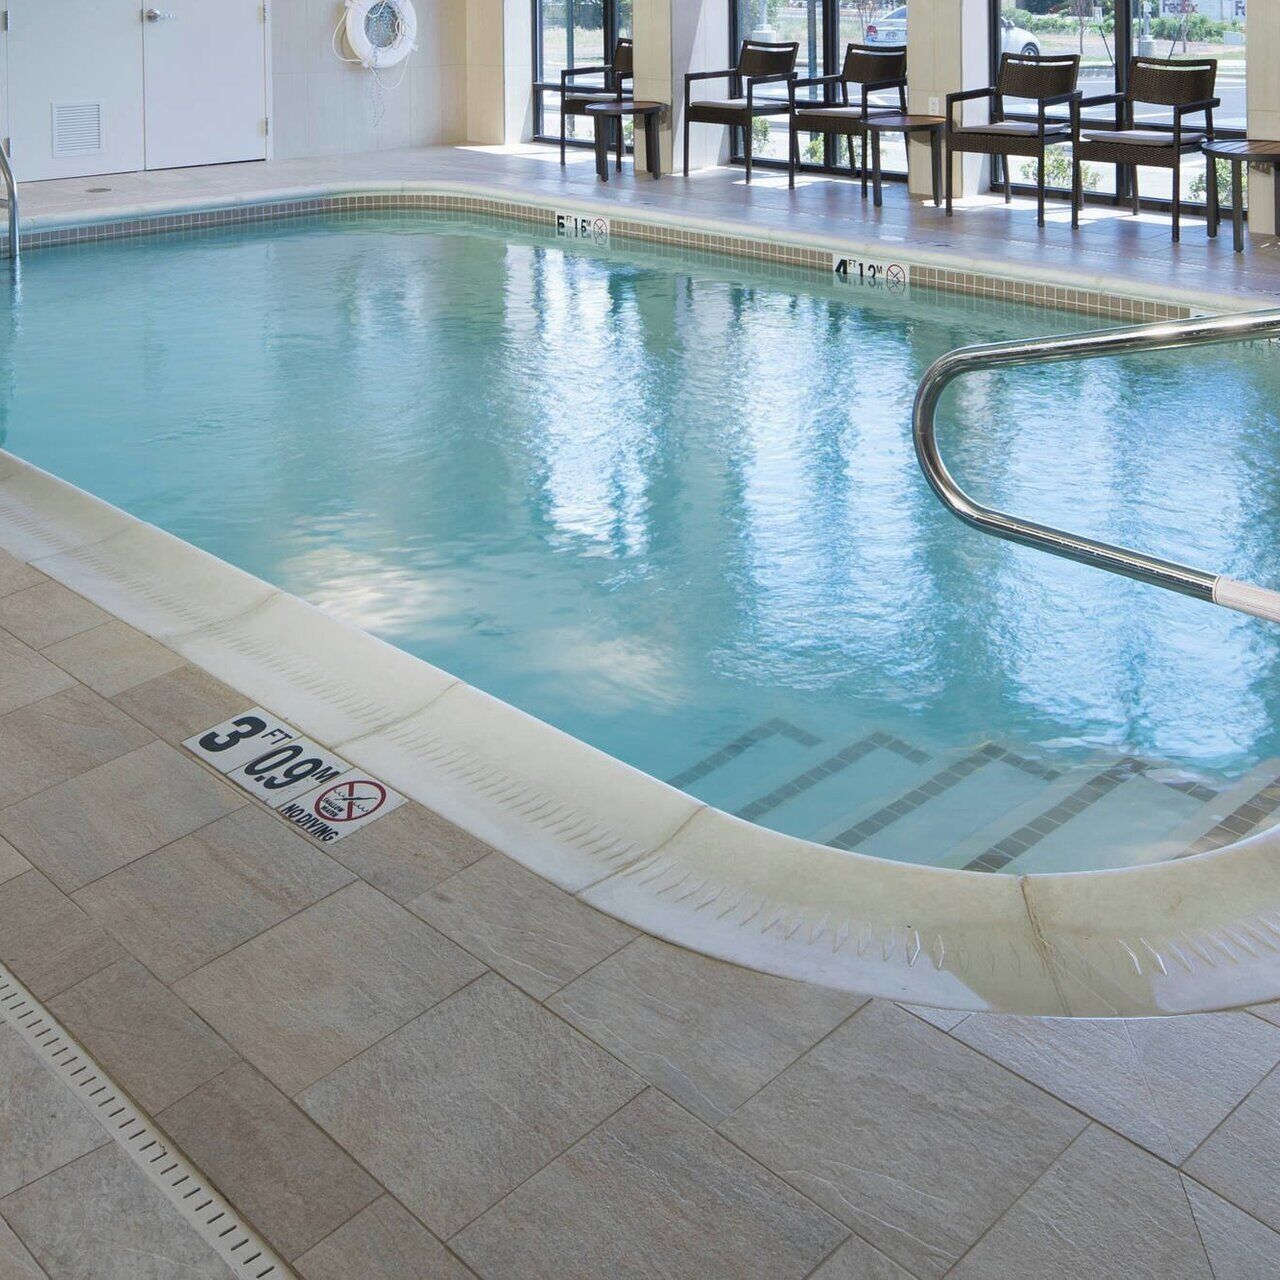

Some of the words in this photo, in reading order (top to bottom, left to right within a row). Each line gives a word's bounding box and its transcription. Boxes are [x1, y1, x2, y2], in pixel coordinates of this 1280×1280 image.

[835, 258, 848, 275] 4
[848, 259, 857, 268] FT
[876, 265, 883, 275] M
[198, 716, 267, 752] 3
[261, 728, 293, 745] FT
[244, 744, 324, 790] 0.9
[311, 765, 340, 784] M
[321, 805, 339, 818] WATER
[323, 797, 345, 813] SHALLOW
[281, 803, 302, 819] NO
[298, 812, 339, 842] DIVING
